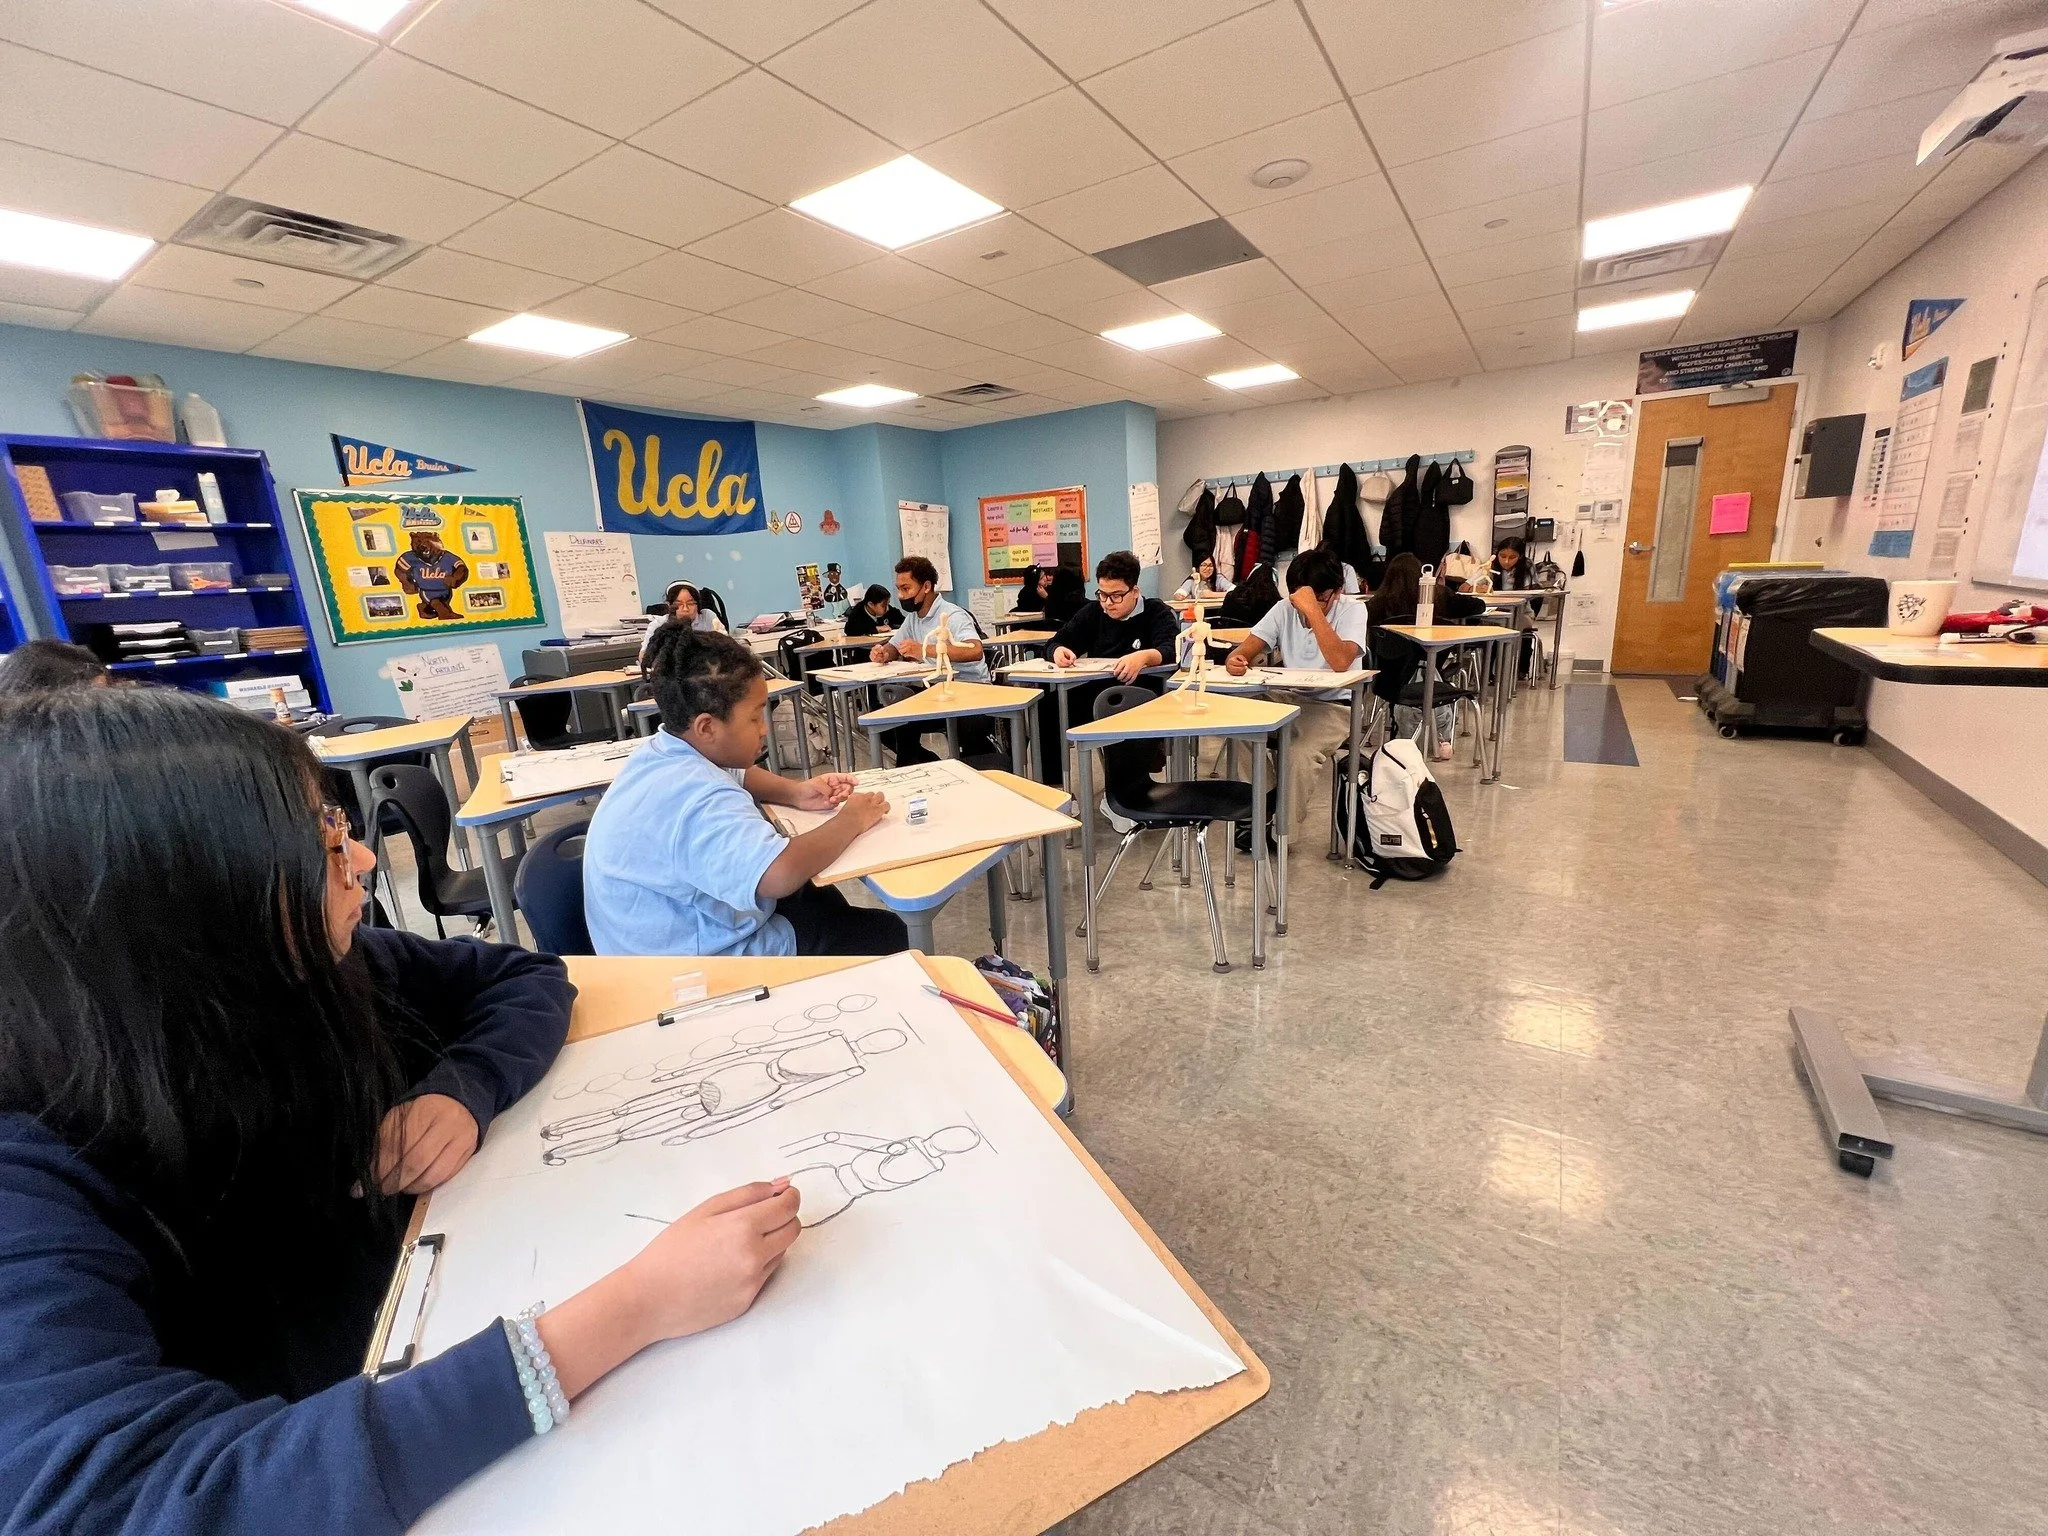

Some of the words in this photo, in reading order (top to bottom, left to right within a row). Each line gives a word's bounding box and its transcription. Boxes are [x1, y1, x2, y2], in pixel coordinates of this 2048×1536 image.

[1672, 346, 1700, 355] COLLEGE
[1703, 348, 1737, 357] ACADEMIC
[1678, 356, 1724, 368] PROFESSIONAL
[1680, 366, 1713, 374] STRENGTH
[1724, 359, 1764, 368] CHARACTER
[416, 459, 449, 472] Bruins
[422, 656, 448, 668] NORTH
